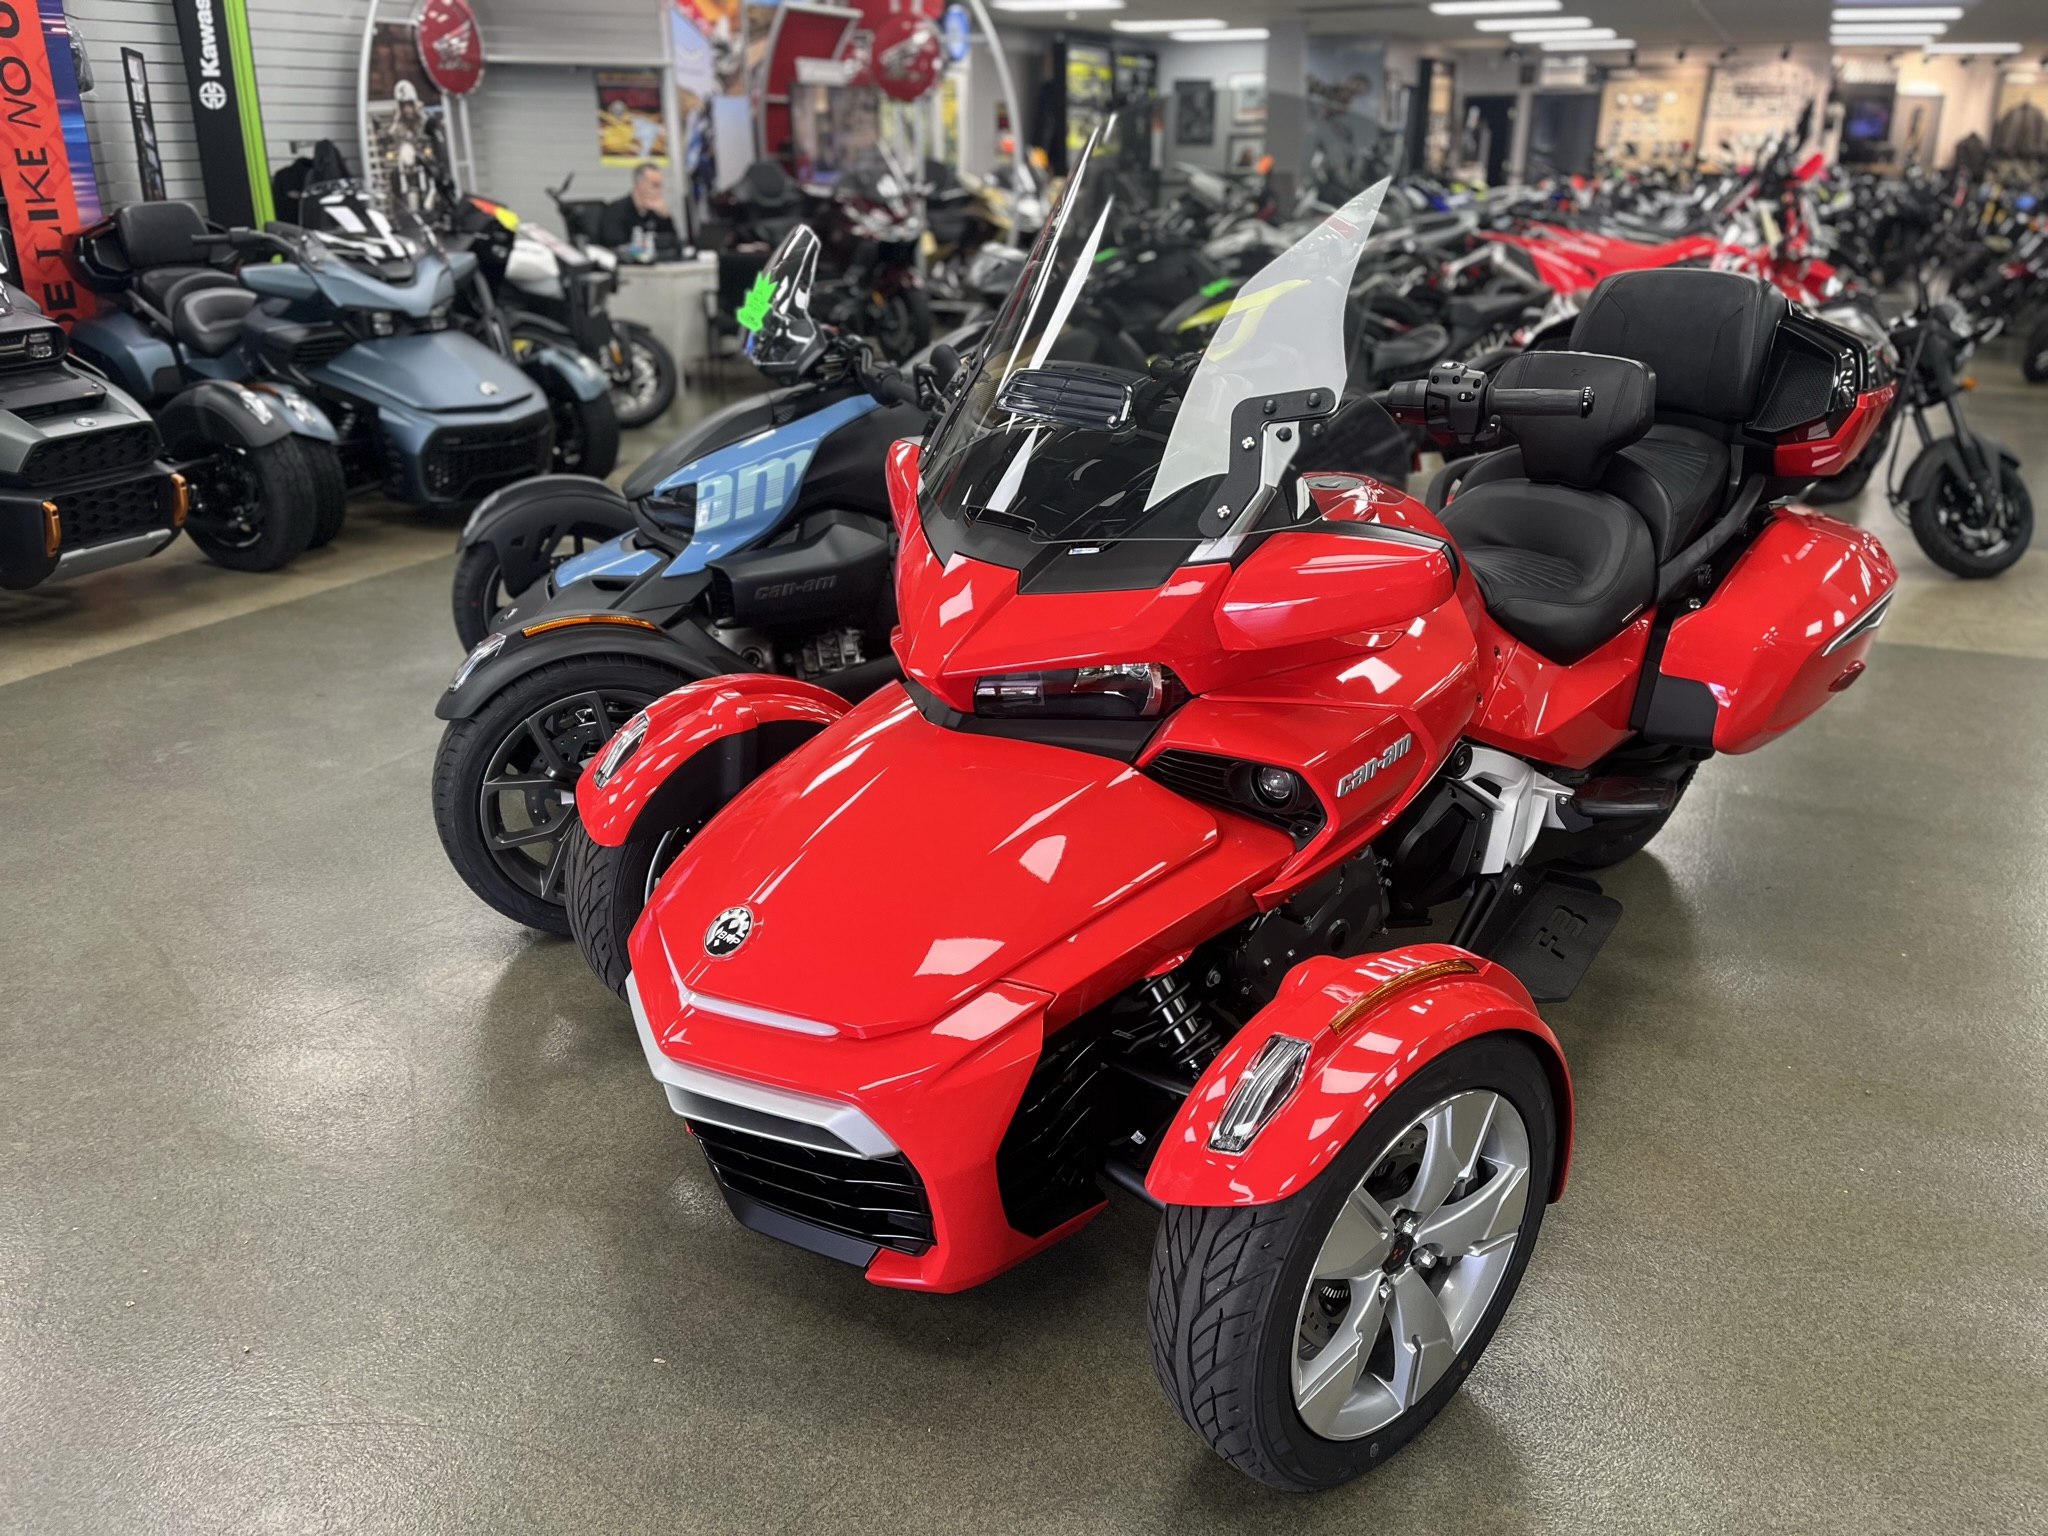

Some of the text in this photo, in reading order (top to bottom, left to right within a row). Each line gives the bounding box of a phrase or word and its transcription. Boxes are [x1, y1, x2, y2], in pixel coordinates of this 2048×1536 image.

[0, 56, 41, 129] NO
[14, 146, 63, 266] LIKE
[754, 575, 838, 600] can-am
[1336, 732, 1412, 798] can-am
[716, 930, 741, 945] BRP
[1529, 904, 1588, 960] F3
